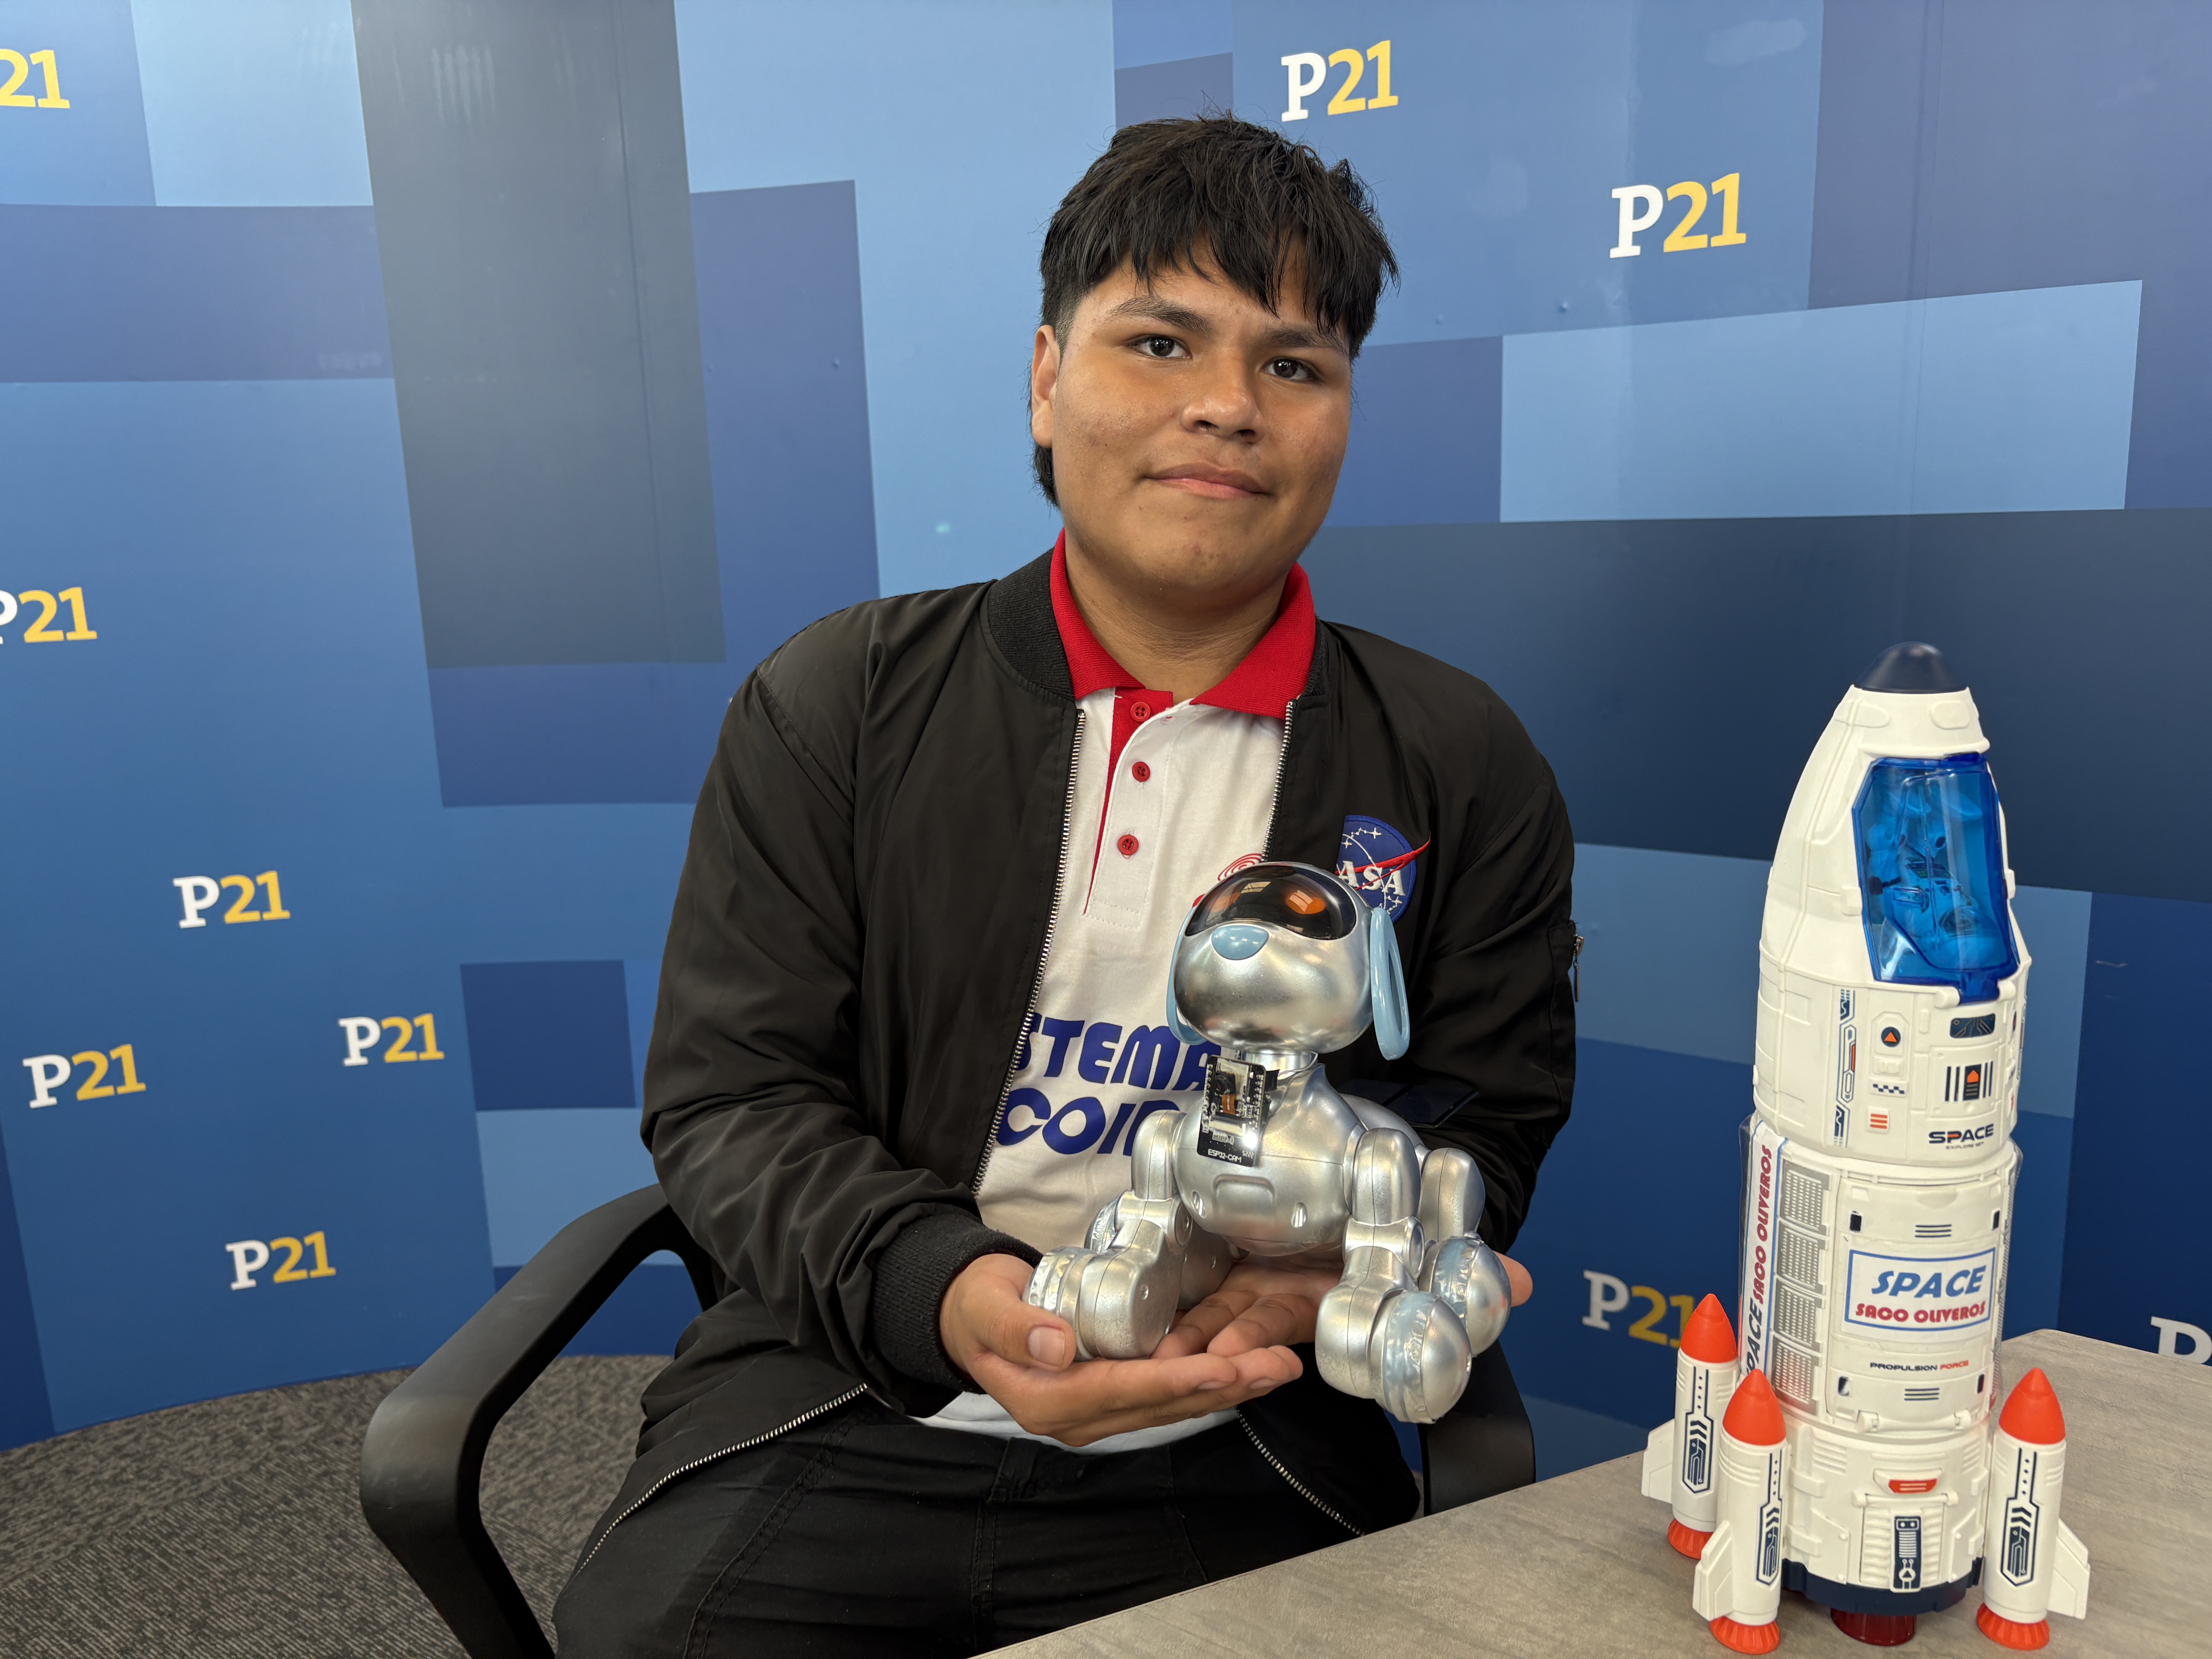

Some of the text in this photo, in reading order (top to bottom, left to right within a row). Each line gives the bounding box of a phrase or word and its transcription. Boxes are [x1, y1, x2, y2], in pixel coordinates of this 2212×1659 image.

[1281, 40, 1398, 122] P21
[1609, 172, 1746, 258] P21
[173, 871, 290, 928] P21
[1337, 860, 1406, 896] ASA
[338, 1013, 445, 1066] P21
[22, 1044, 146, 1109] P21
[1207, 1148, 1242, 1163] ESP32-CAM
[1929, 1123, 1994, 1144] SPACE
[226, 1231, 336, 1290] P21
[1747, 1144, 1772, 1374] PACE SACO OLIVEROS
[1871, 1265, 1986, 1298] SPACE
[1855, 1301, 1986, 1323] SACO OLIVEROS
[1870, 1360, 1969, 1371] PROPULSION FORCE
